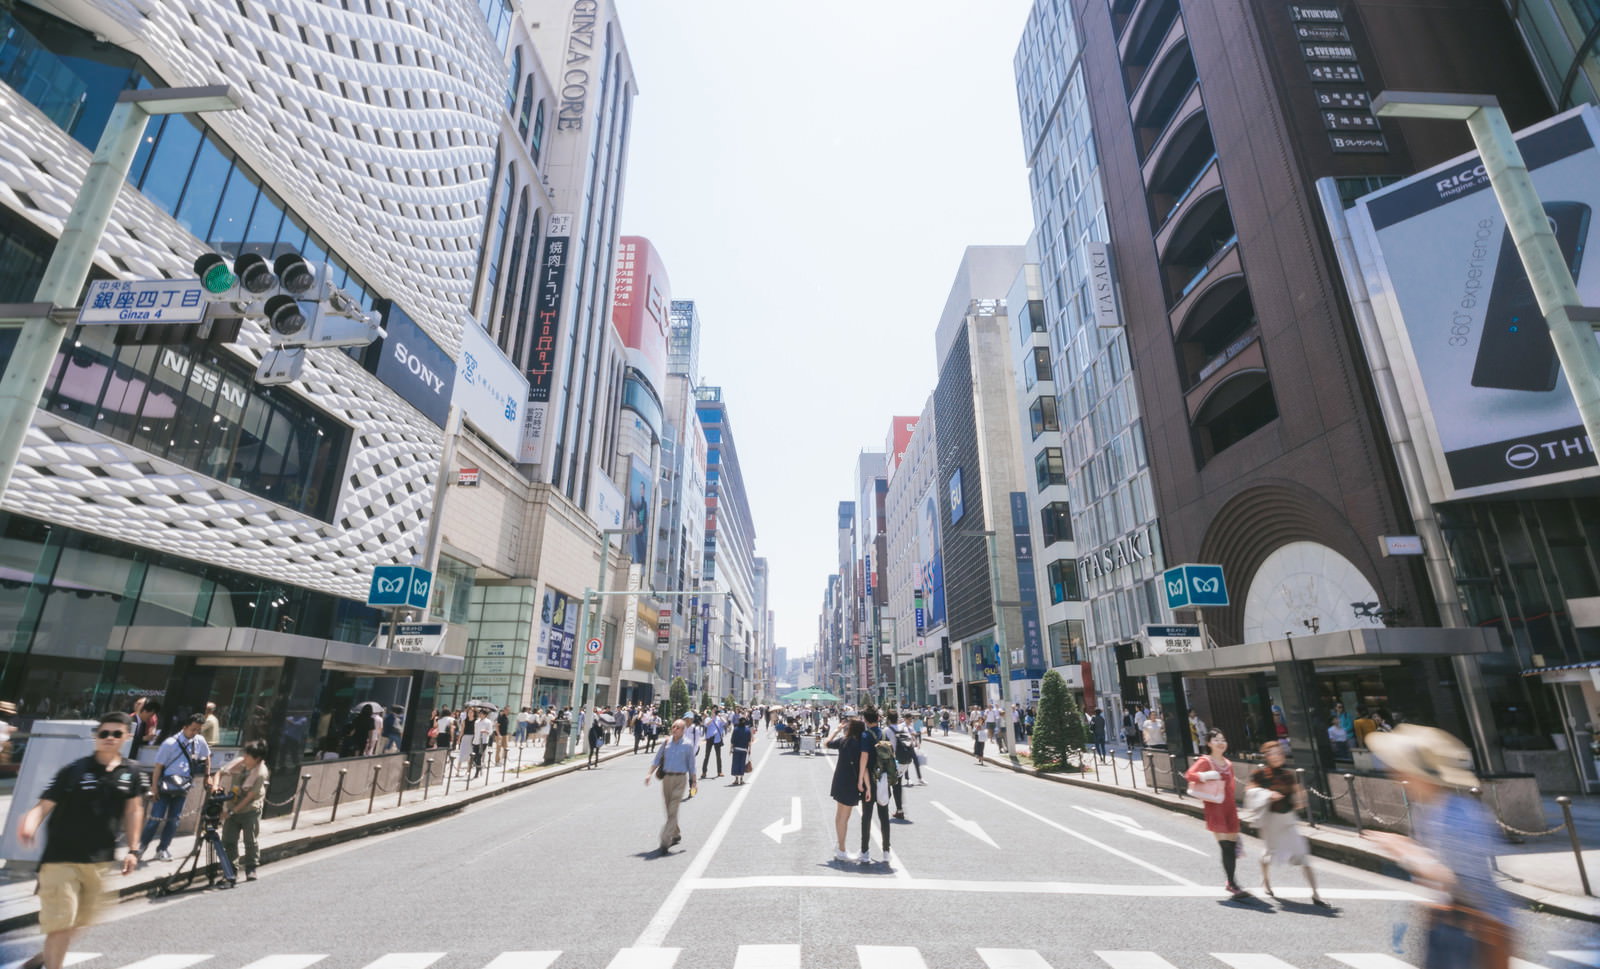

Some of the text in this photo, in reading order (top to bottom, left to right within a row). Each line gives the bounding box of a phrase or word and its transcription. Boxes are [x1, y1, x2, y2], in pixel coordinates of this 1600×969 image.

[1305, 47, 1315, 57] 5
[556, 0, 598, 132] GINZA CORE
[1312, 68, 1322, 77] 4
[1320, 94, 1331, 104] 3
[1333, 138, 1345, 148] B
[551, 225, 568, 234] 2F
[545, 241, 564, 307] 焼肉トラジ
[1092, 251, 1115, 317] TASAKI
[99, 281, 133, 291] 中央区
[91, 289, 202, 309] 銀座四丁目
[119, 309, 163, 320] Ginza 4
[162, 349, 247, 408] NISSAN
[394, 342, 446, 395] SONY
[951, 483, 962, 510] GU
[1079, 528, 1153, 583] TASAKI
